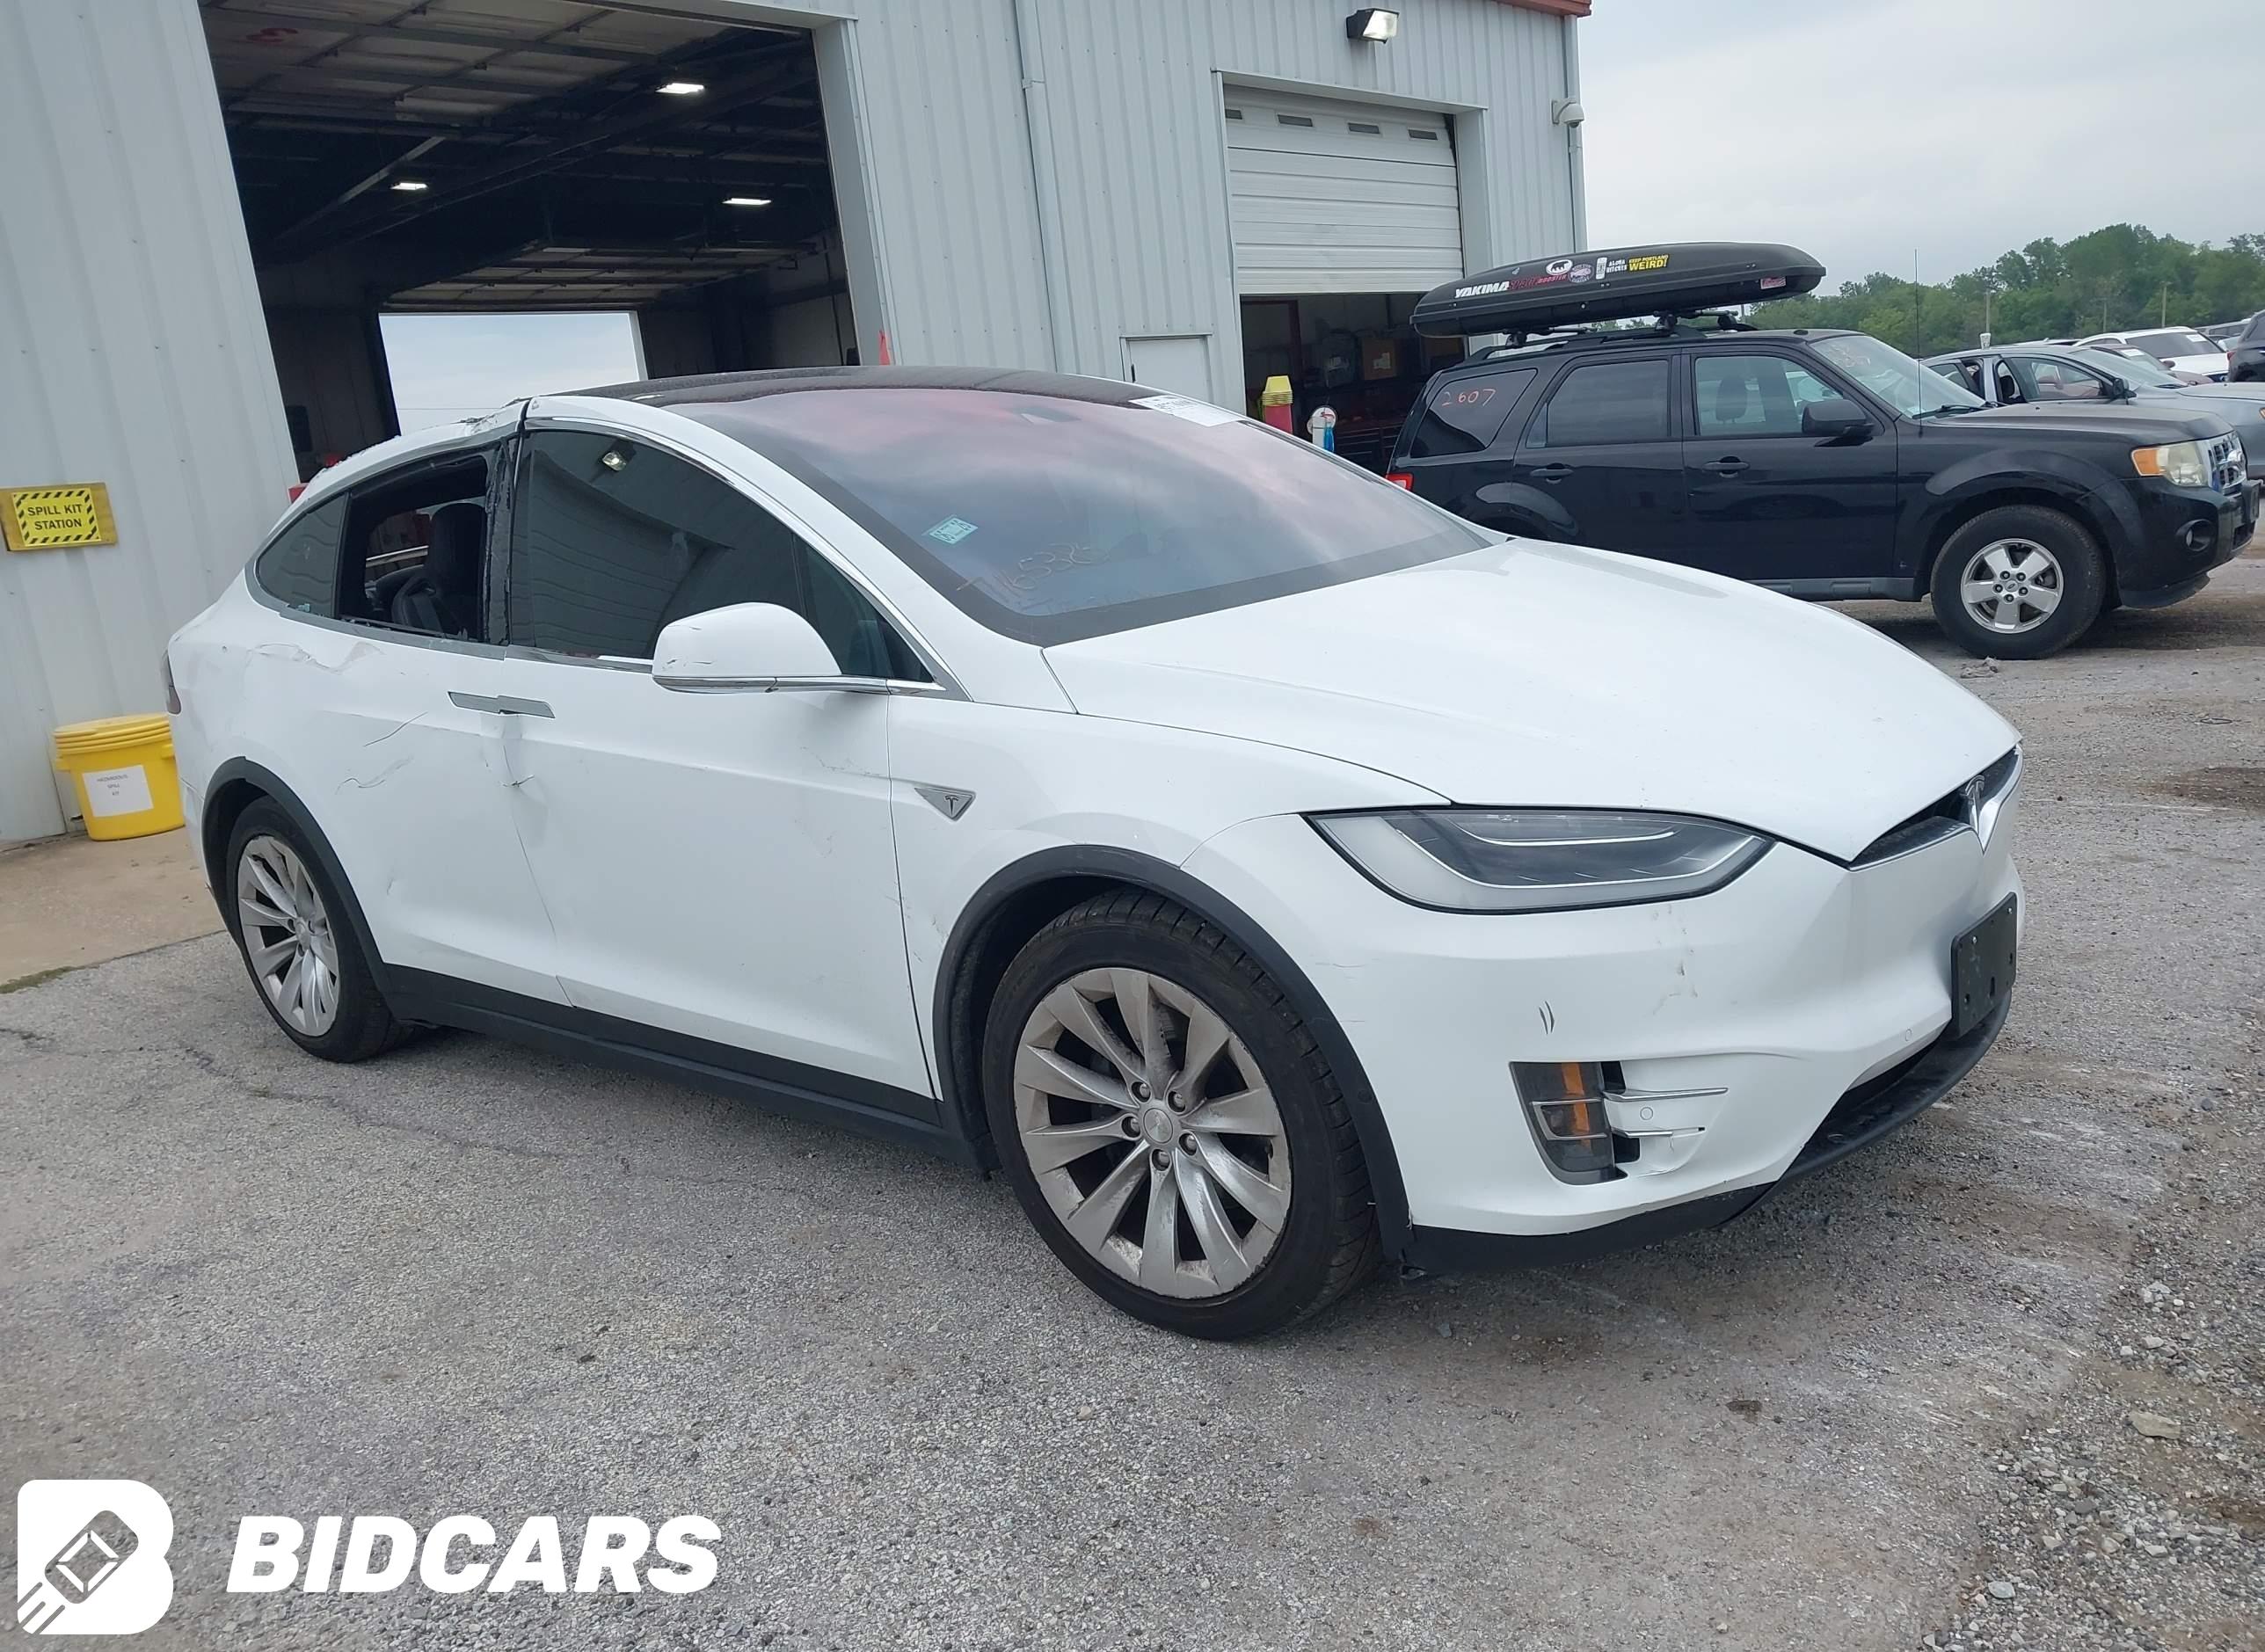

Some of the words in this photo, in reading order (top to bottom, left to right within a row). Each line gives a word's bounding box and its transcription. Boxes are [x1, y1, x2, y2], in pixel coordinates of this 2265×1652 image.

[1629, 257, 1668, 271] WEIRD!
[1454, 280, 1510, 298] YAKIMA
[27, 506, 61, 516] SPILL
[64, 504, 82, 514] KIT
[34, 518, 82, 530] STATION
